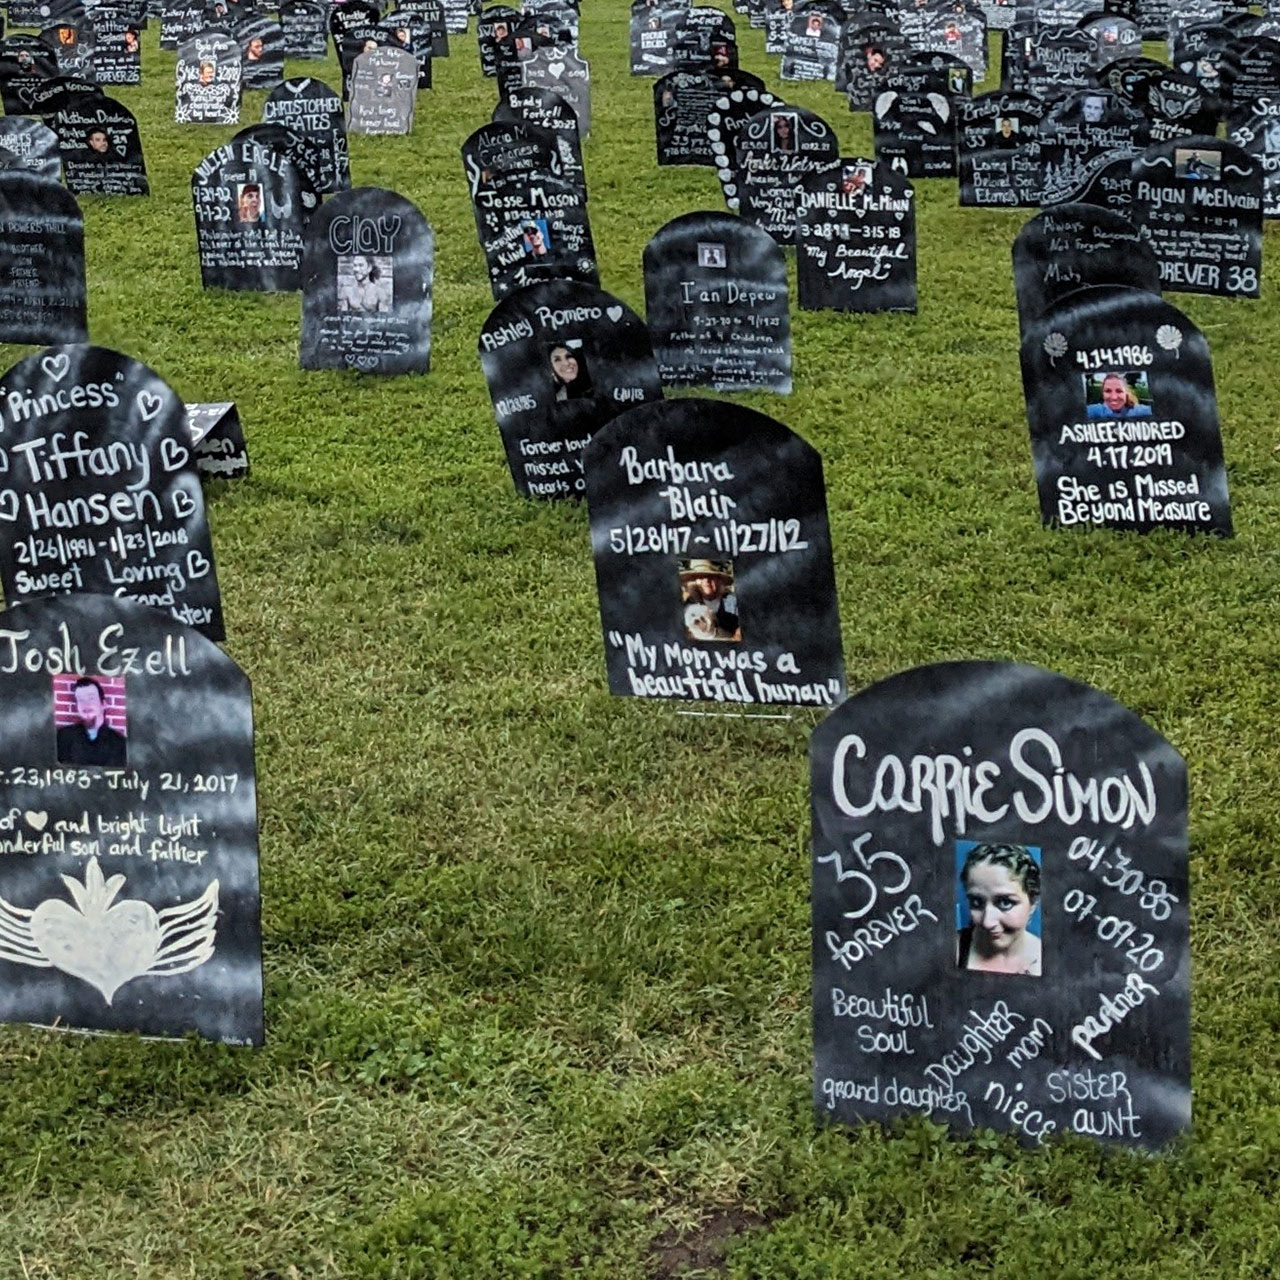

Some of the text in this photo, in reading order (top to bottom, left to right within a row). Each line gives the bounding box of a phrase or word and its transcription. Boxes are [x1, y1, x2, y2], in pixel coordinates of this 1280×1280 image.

[264, 97, 343, 118] CHRISTOPHER
[284, 114, 331, 131] GATES
[1231, 127, 1254, 147] 33
[194, 143, 289, 184] JULIEN EAGLE
[478, 191, 529, 208] Jesse
[801, 192, 856, 210] DANIELLE
[835, 243, 908, 260] Beautiful
[1226, 266, 1257, 292] 38
[727, 284, 776, 307] Depew
[481, 305, 601, 351] Ashley Romero
[1076, 345, 1153, 369] 4.14.1986
[11, 431, 149, 491] Tiffany
[620, 445, 734, 485] Barbara
[1087, 444, 1173, 469] 4.17.2019
[1057, 476, 1101, 502] She
[1135, 474, 1199, 498] Missed
[25, 490, 163, 531] Hansen
[659, 486, 736, 521] Blair
[1058, 498, 1212, 525] Beyond Measure
[15, 556, 181, 594] Sweet Loving
[97, 622, 192, 677] Ezell
[664, 643, 801, 673] Mom was a
[628, 669, 753, 702] beautiful
[54, 810, 91, 834] and
[98, 815, 150, 840] bright
[70, 840, 102, 857] son
[109, 835, 142, 856] and
[147, 840, 208, 865] father
[817, 831, 911, 920] 35
[1066, 834, 1179, 922] 04-30-85
[1063, 887, 1166, 973] 07-09-20
[858, 1025, 915, 1055] Soul
